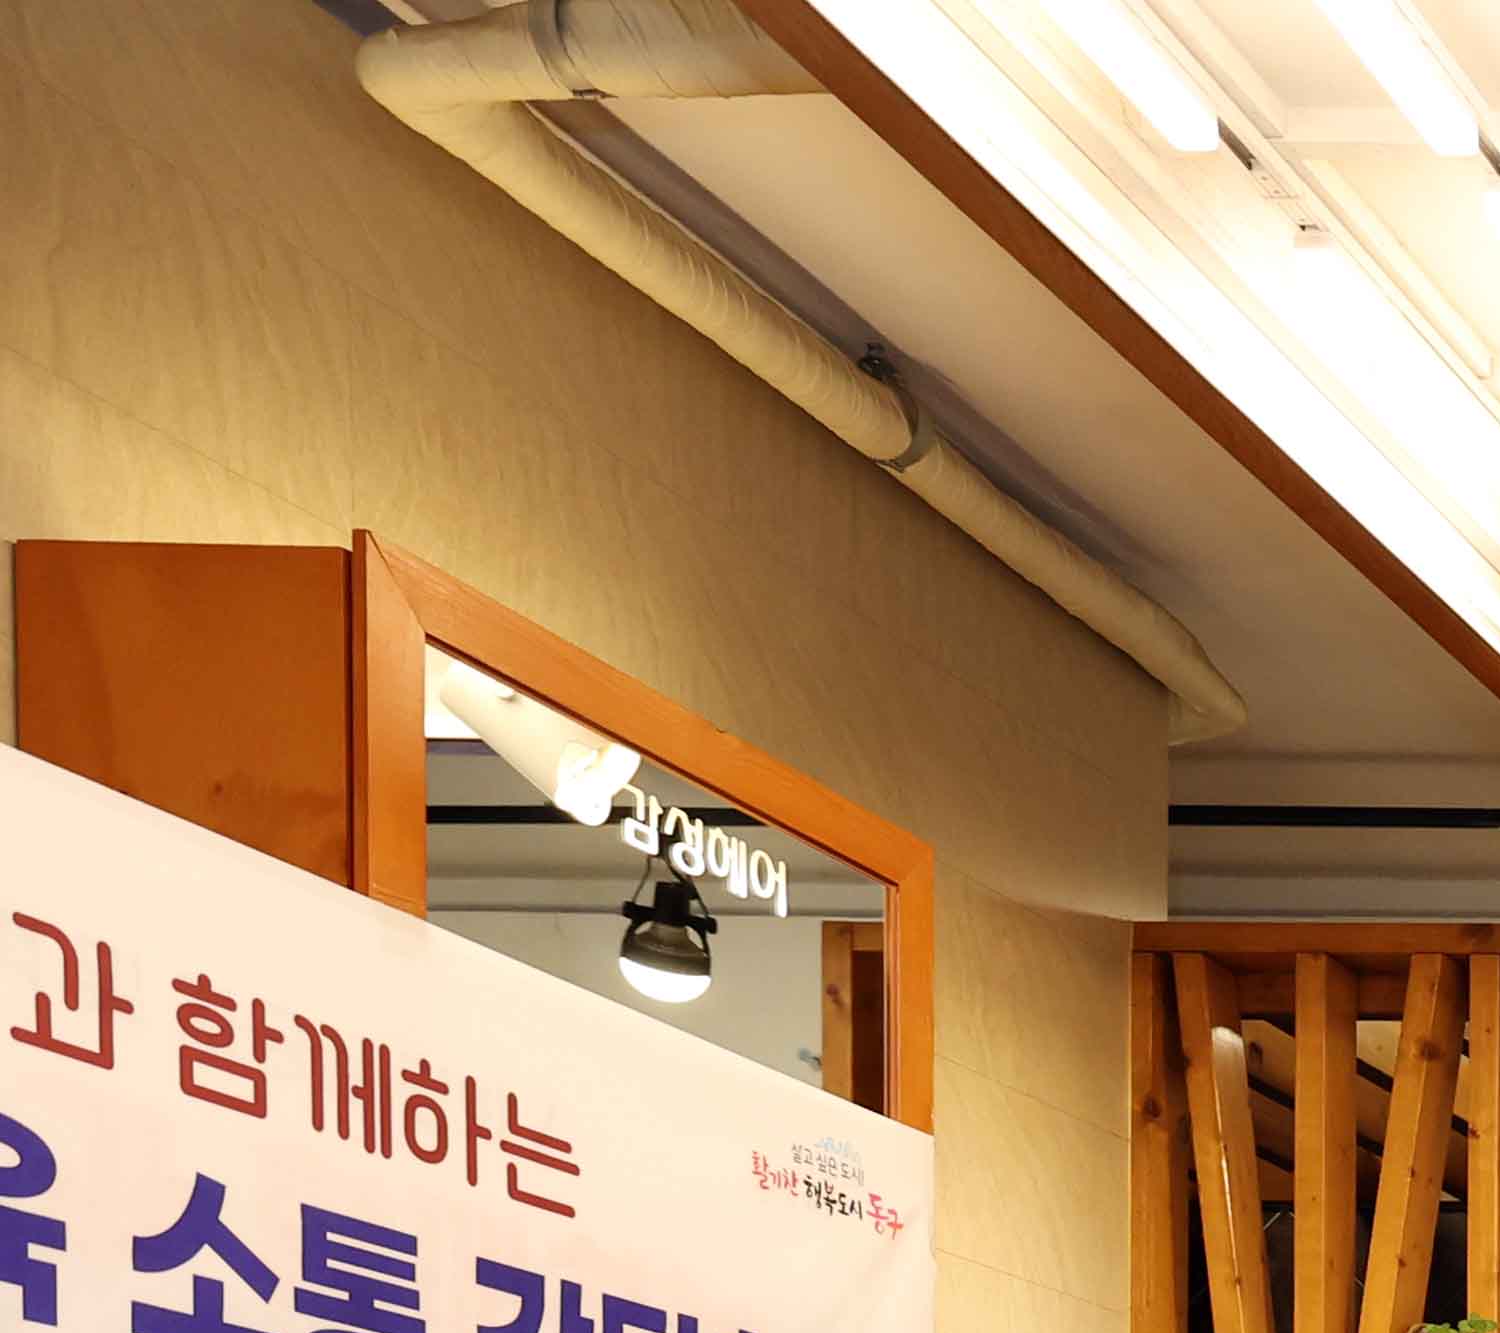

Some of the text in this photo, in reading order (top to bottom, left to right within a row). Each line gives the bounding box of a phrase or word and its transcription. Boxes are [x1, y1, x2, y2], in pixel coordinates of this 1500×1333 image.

[621, 783, 788, 918] 감성헤어
[10, 911, 580, 1218] 과 함께하는
[866, 1192, 905, 1241] 동구
